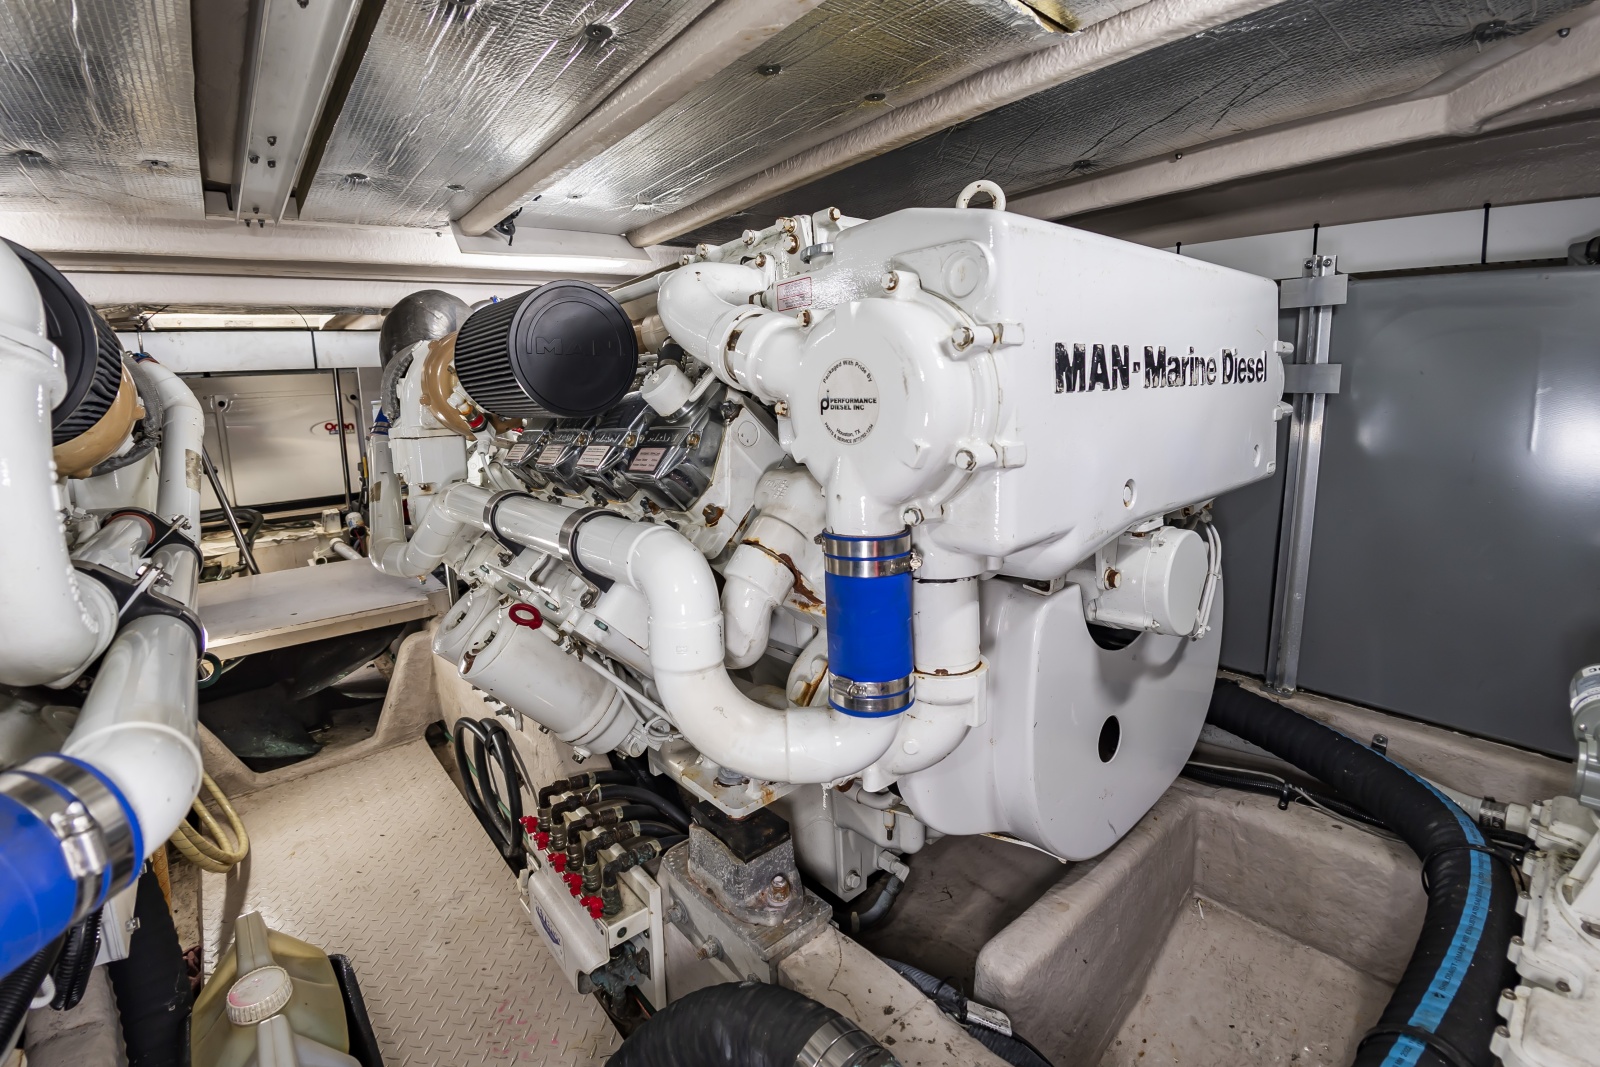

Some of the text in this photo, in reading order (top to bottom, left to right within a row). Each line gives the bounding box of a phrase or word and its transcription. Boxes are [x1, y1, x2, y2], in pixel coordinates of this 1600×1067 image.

[822, 361, 842, 384] Packaged
[855, 362, 867, 374] Pride
[866, 372, 872, 382] By
[1221, 347, 1267, 385] Diesel
